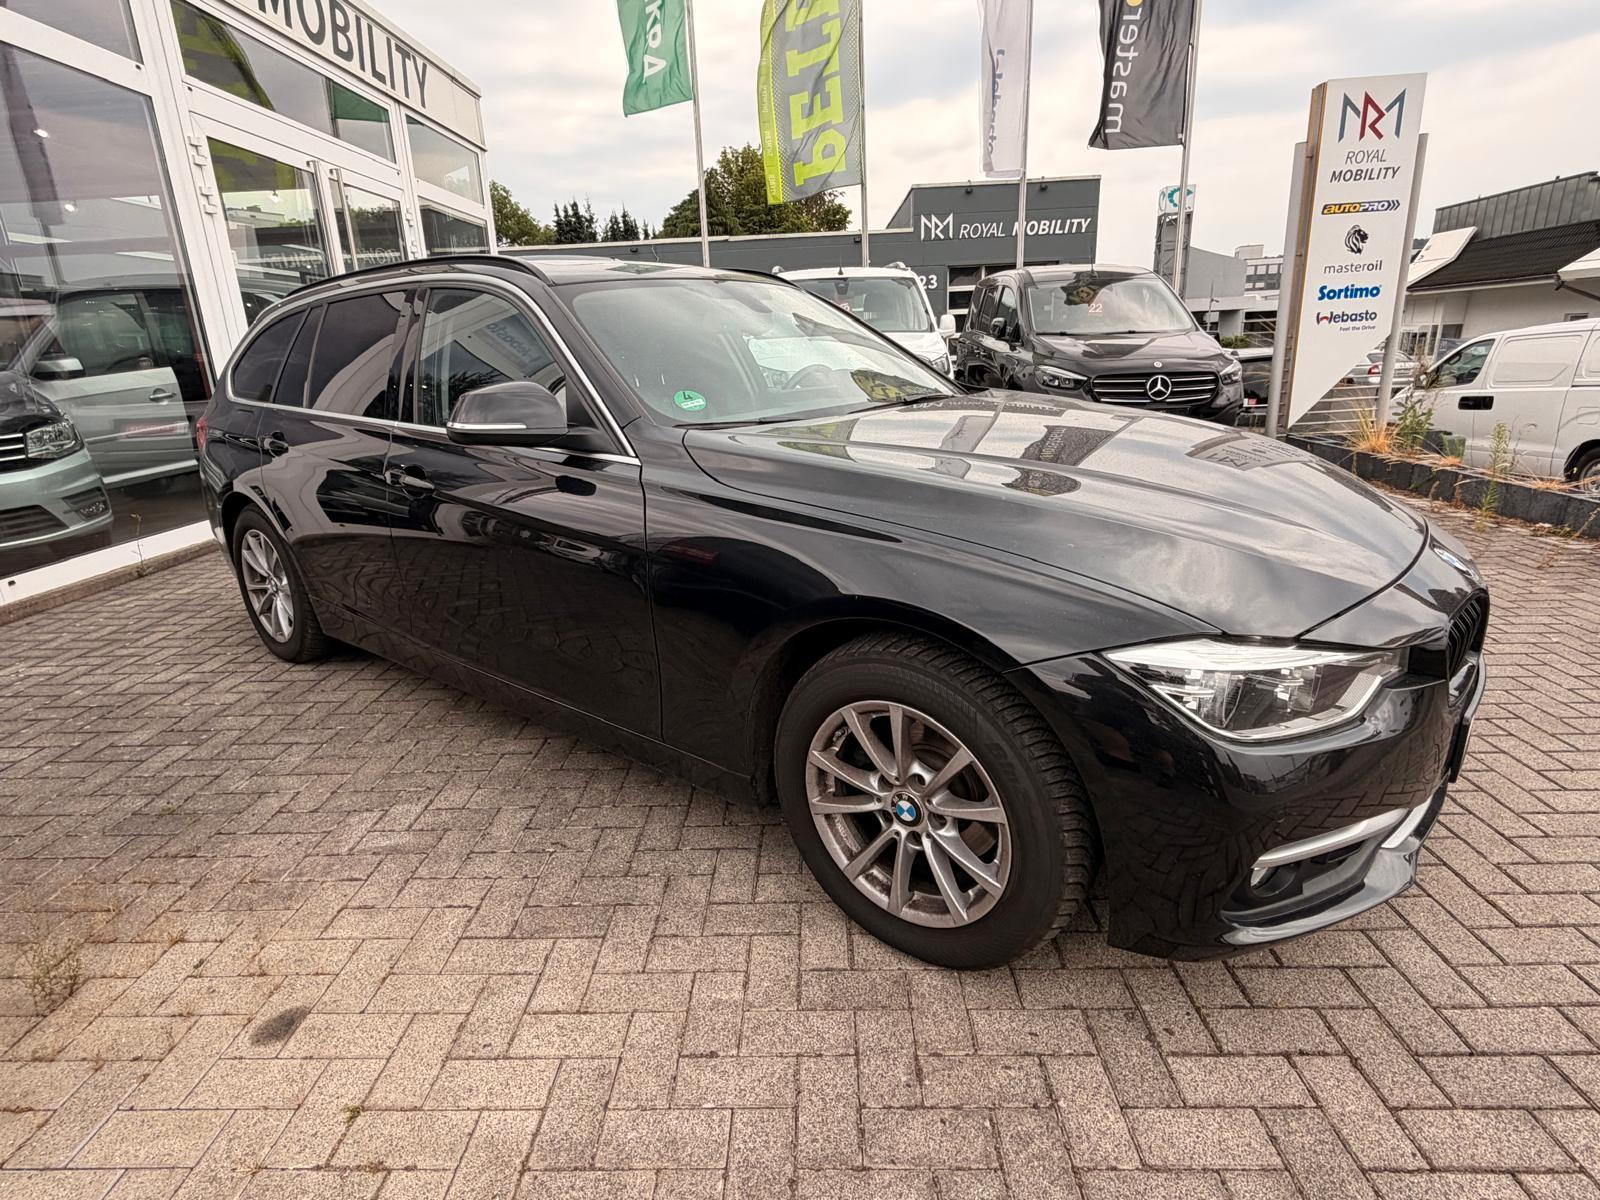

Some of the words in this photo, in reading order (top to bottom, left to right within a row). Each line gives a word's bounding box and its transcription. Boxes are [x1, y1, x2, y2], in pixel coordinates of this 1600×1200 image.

[1345, 149, 1387, 165] ROYAL
[1329, 166, 1401, 184] MOBILITY
[959, 222, 1006, 239] ROYAL
[1323, 259, 1383, 275] masteroil
[1088, 303, 1103, 313] 22
[1316, 310, 1378, 326] Webasto
